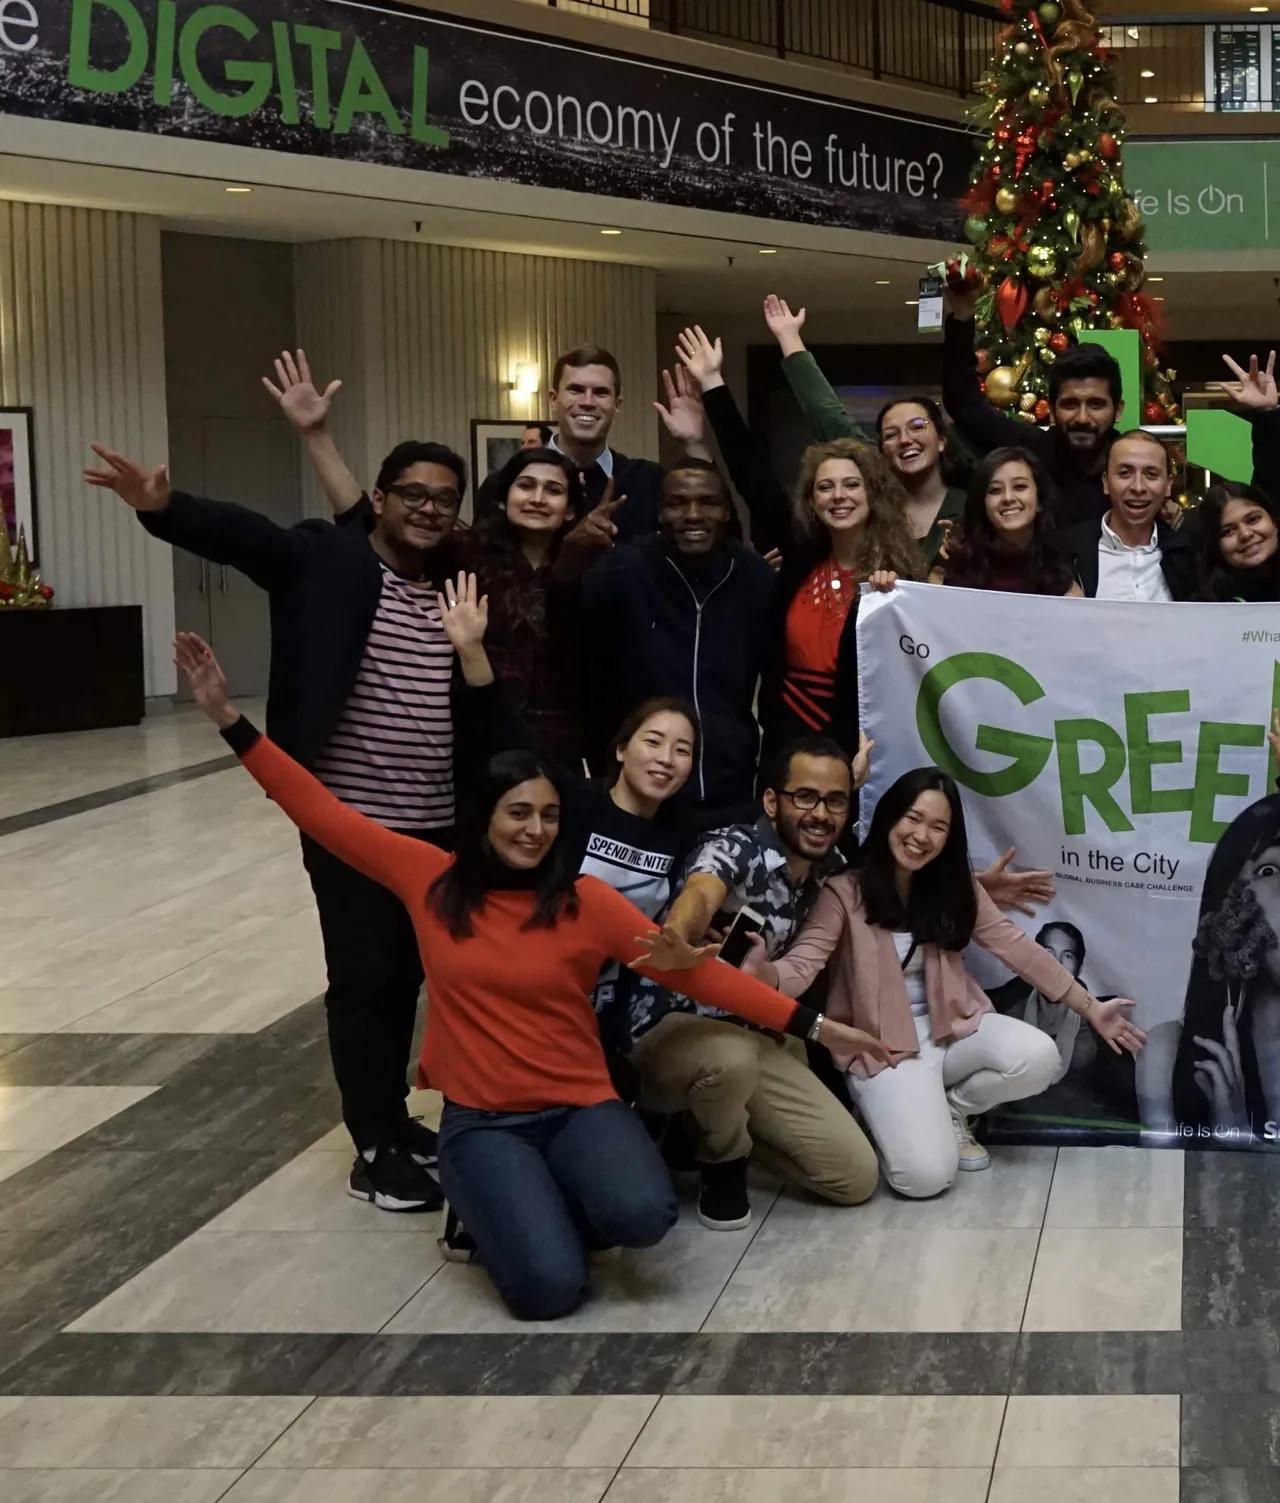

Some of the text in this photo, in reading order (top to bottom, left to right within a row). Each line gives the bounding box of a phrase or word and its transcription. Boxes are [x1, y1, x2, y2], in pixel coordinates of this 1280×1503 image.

[68, 0, 450, 148] DIGITAL
[459, 79, 681, 168] economy
[696, 113, 735, 165] of
[753, 120, 812, 178] the
[824, 133, 944, 199] future?
[1167, 188, 1191, 215] Is
[1198, 184, 1244, 215] On
[589, 837, 629, 861] SPEND
[1060, 845, 1180, 880] in the City
[1054, 871, 1194, 893] GLOBAL BUSINESS CASE CHALLENGE
[1165, 1120, 1240, 1139] Life Is On
